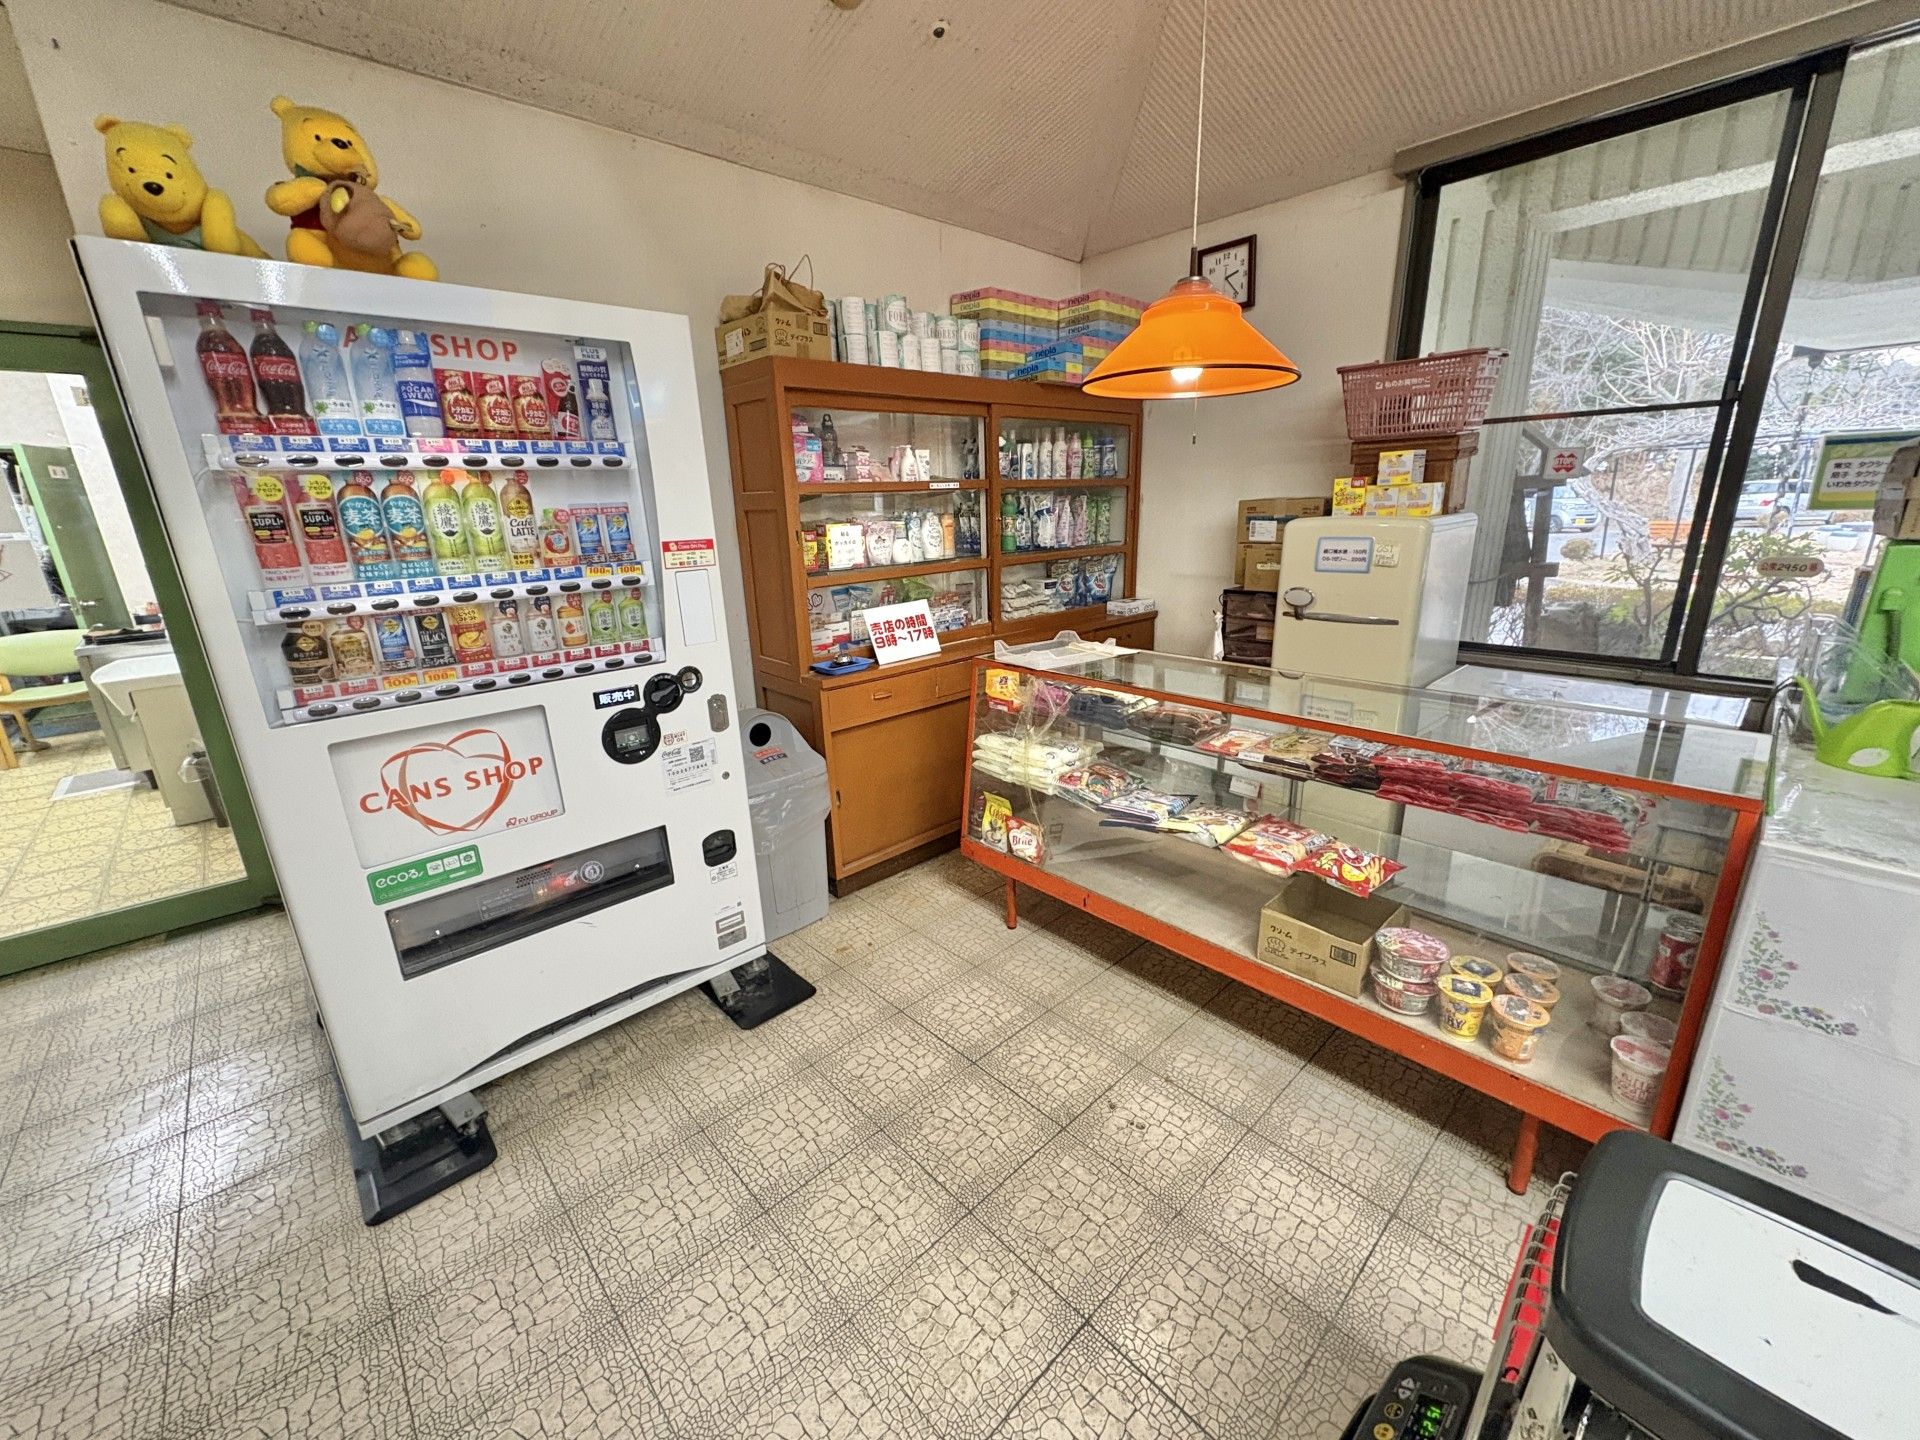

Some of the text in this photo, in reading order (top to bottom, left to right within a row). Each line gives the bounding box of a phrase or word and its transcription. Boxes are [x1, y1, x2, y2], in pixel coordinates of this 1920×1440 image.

[430, 334, 518, 362] SHOP
[1035, 344, 1057, 359] nepia
[207, 361, 248, 376] Coca-Cola
[259, 362, 296, 377] Coca-Cola
[1016, 363, 1039, 376] nepia
[400, 385, 435, 394] POCARI
[402, 392, 434, 400] SWEAT
[343, 508, 380, 526] 麦茶
[387, 507, 422, 525] 麦茶
[509, 518, 534, 527] Café
[510, 526, 536, 537] LATTE
[869, 613, 928, 637] 売店の時間
[598, 689, 635, 705] 販売中
[359, 756, 544, 815] CANS SHOP
[530, 808, 559, 824] GROUP
[1270, 925, 1293, 939] クリーム
